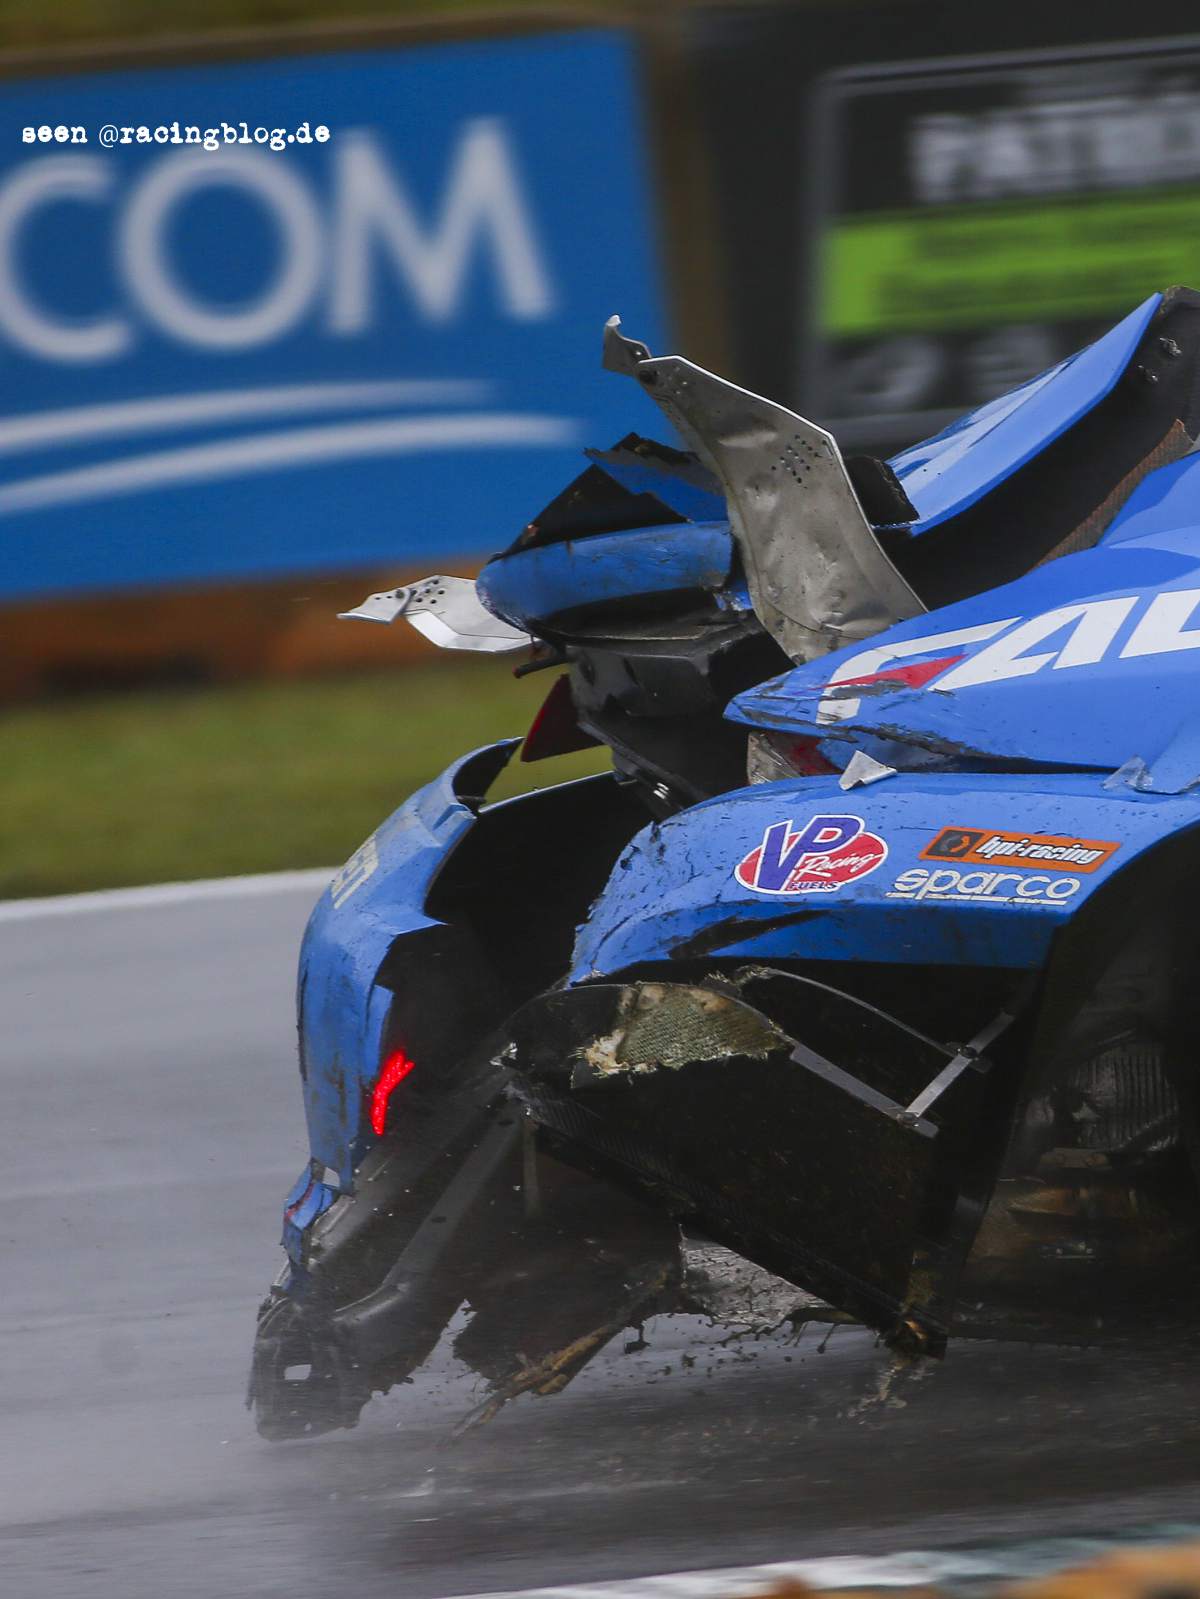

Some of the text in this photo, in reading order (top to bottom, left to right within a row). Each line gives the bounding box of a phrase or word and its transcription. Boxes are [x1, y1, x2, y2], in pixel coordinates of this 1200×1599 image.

[0, 116, 555, 364] COM
[755, 815, 865, 892] VP
[799, 853, 883, 878] Racing
[791, 880, 838, 890] FUELS
[894, 866, 1082, 901] sparco
